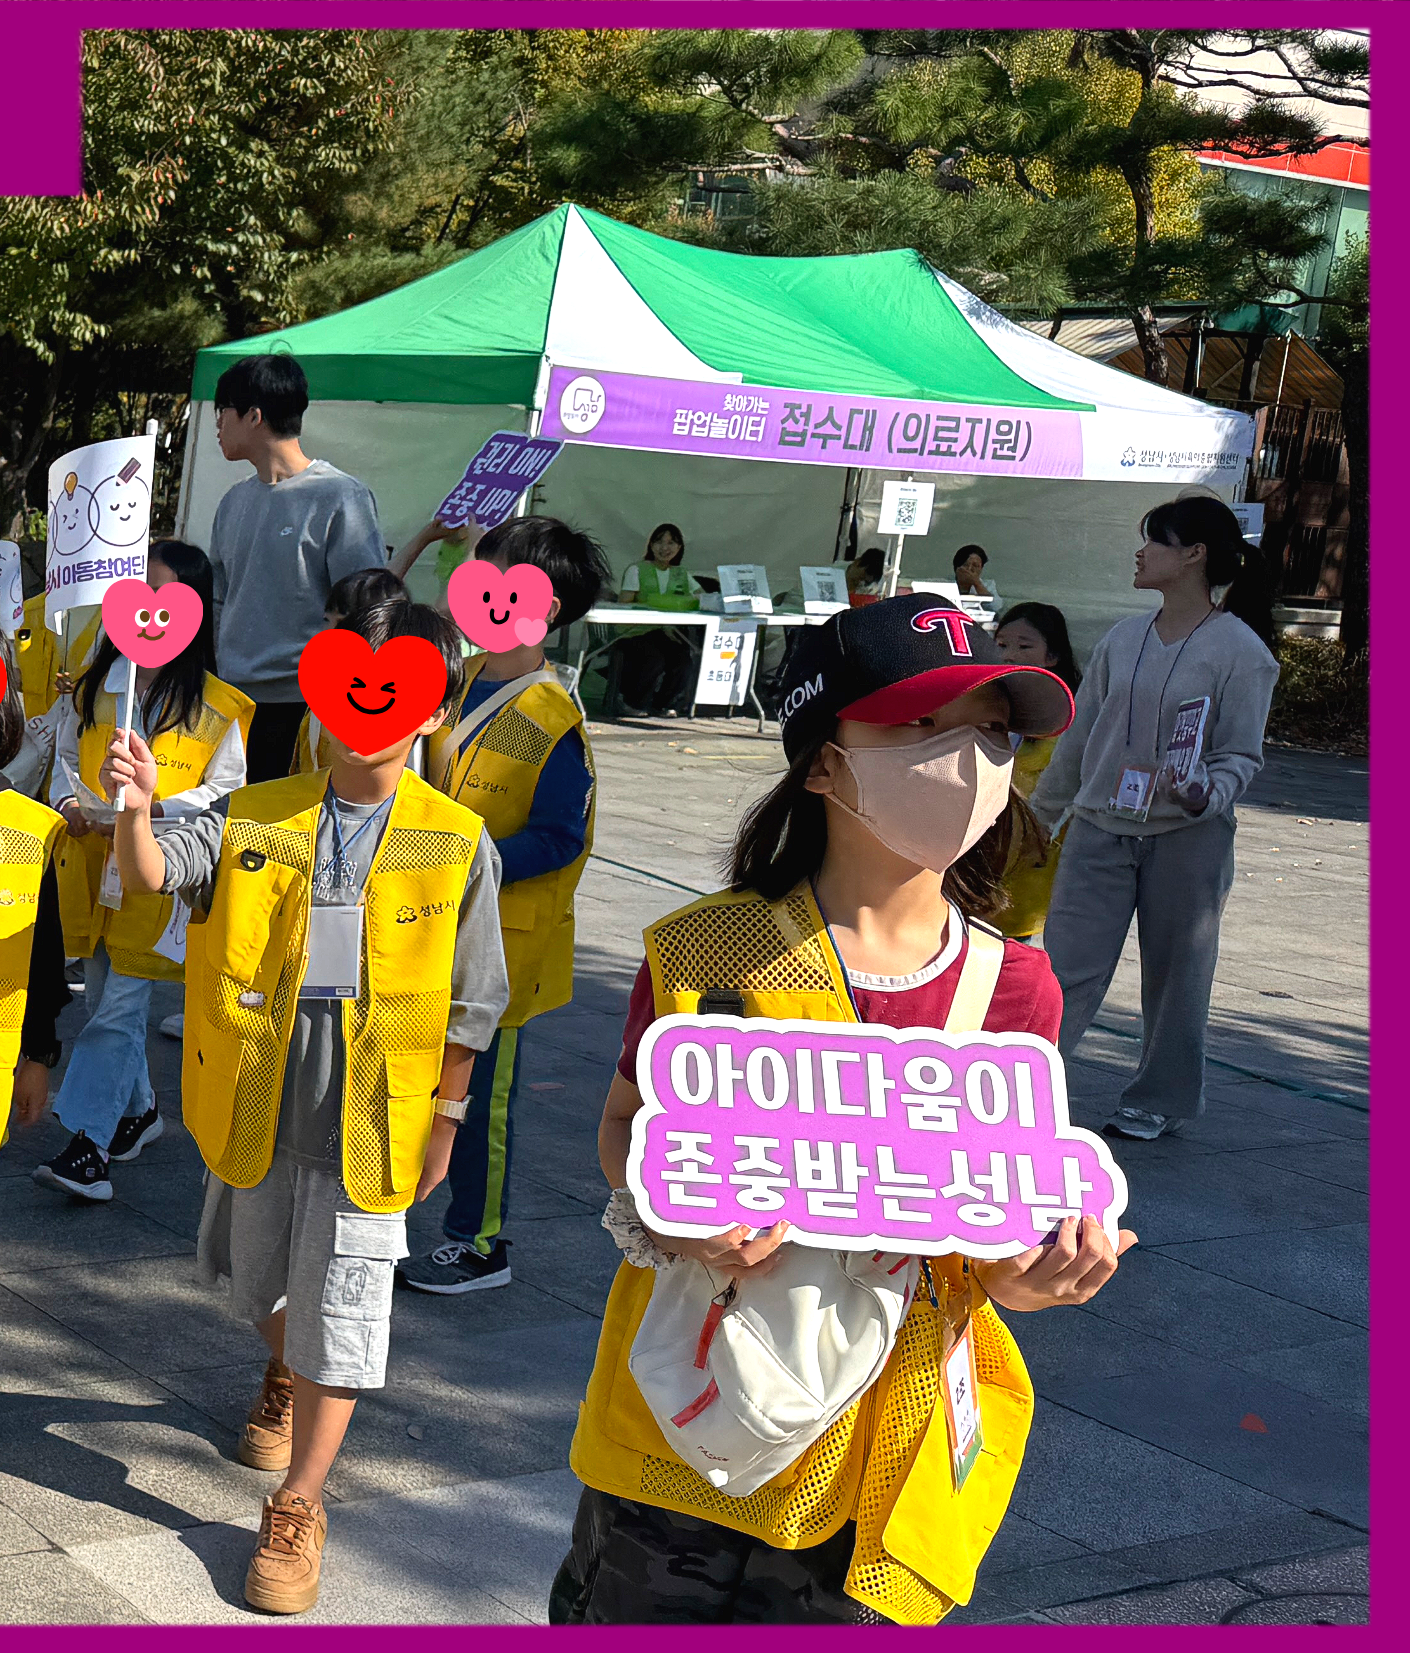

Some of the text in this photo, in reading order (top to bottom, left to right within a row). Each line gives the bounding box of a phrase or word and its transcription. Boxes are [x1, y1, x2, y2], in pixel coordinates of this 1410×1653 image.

[722, 392, 771, 415] 찾아가는
[671, 408, 767, 442] 팝업놀이터
[777, 402, 1033, 462] 접수대 (의료지원)
[473, 441, 552, 479] 권리 ON!
[441, 481, 518, 519] 존중 UP!
[419, 900, 456, 918] 성남시
[670, 1041, 1037, 1133] 아이다움이
